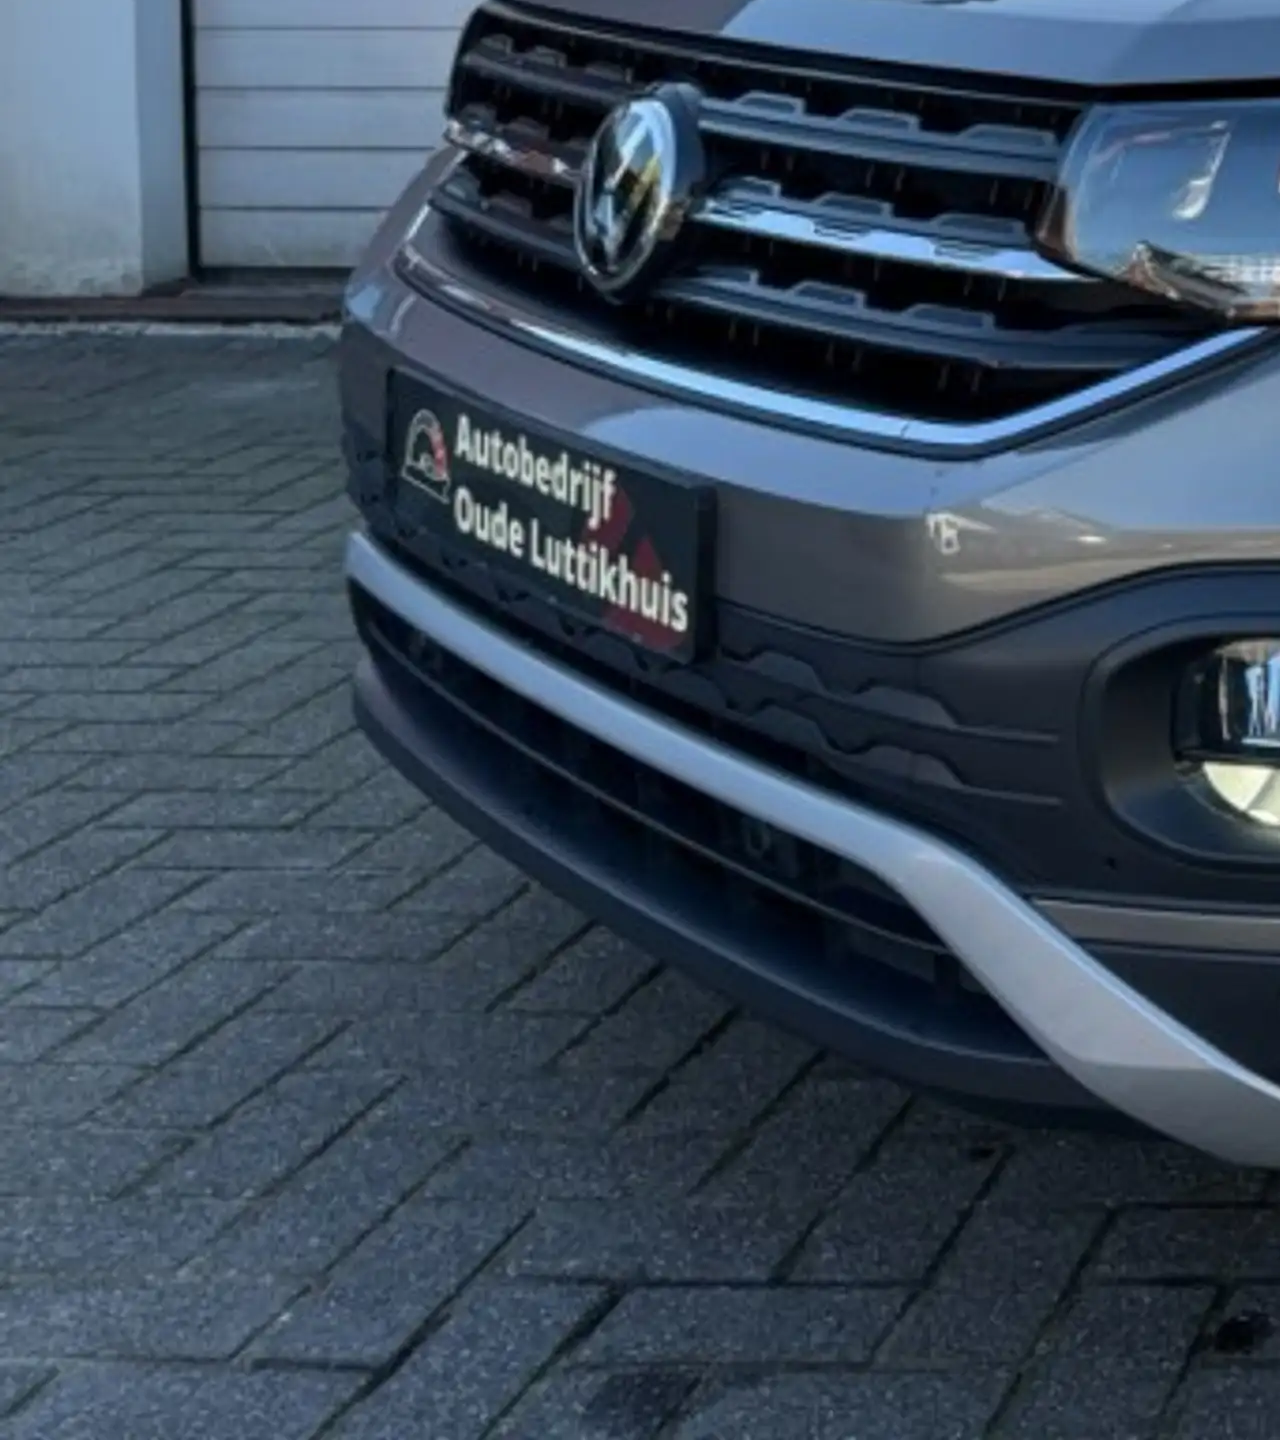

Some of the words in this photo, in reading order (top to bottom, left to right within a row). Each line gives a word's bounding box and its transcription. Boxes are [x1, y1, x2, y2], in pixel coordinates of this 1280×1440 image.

[455, 414, 617, 530] Autobedrijf
[454, 488, 523, 558] Oude
[531, 518, 689, 633] Luttikhuis
